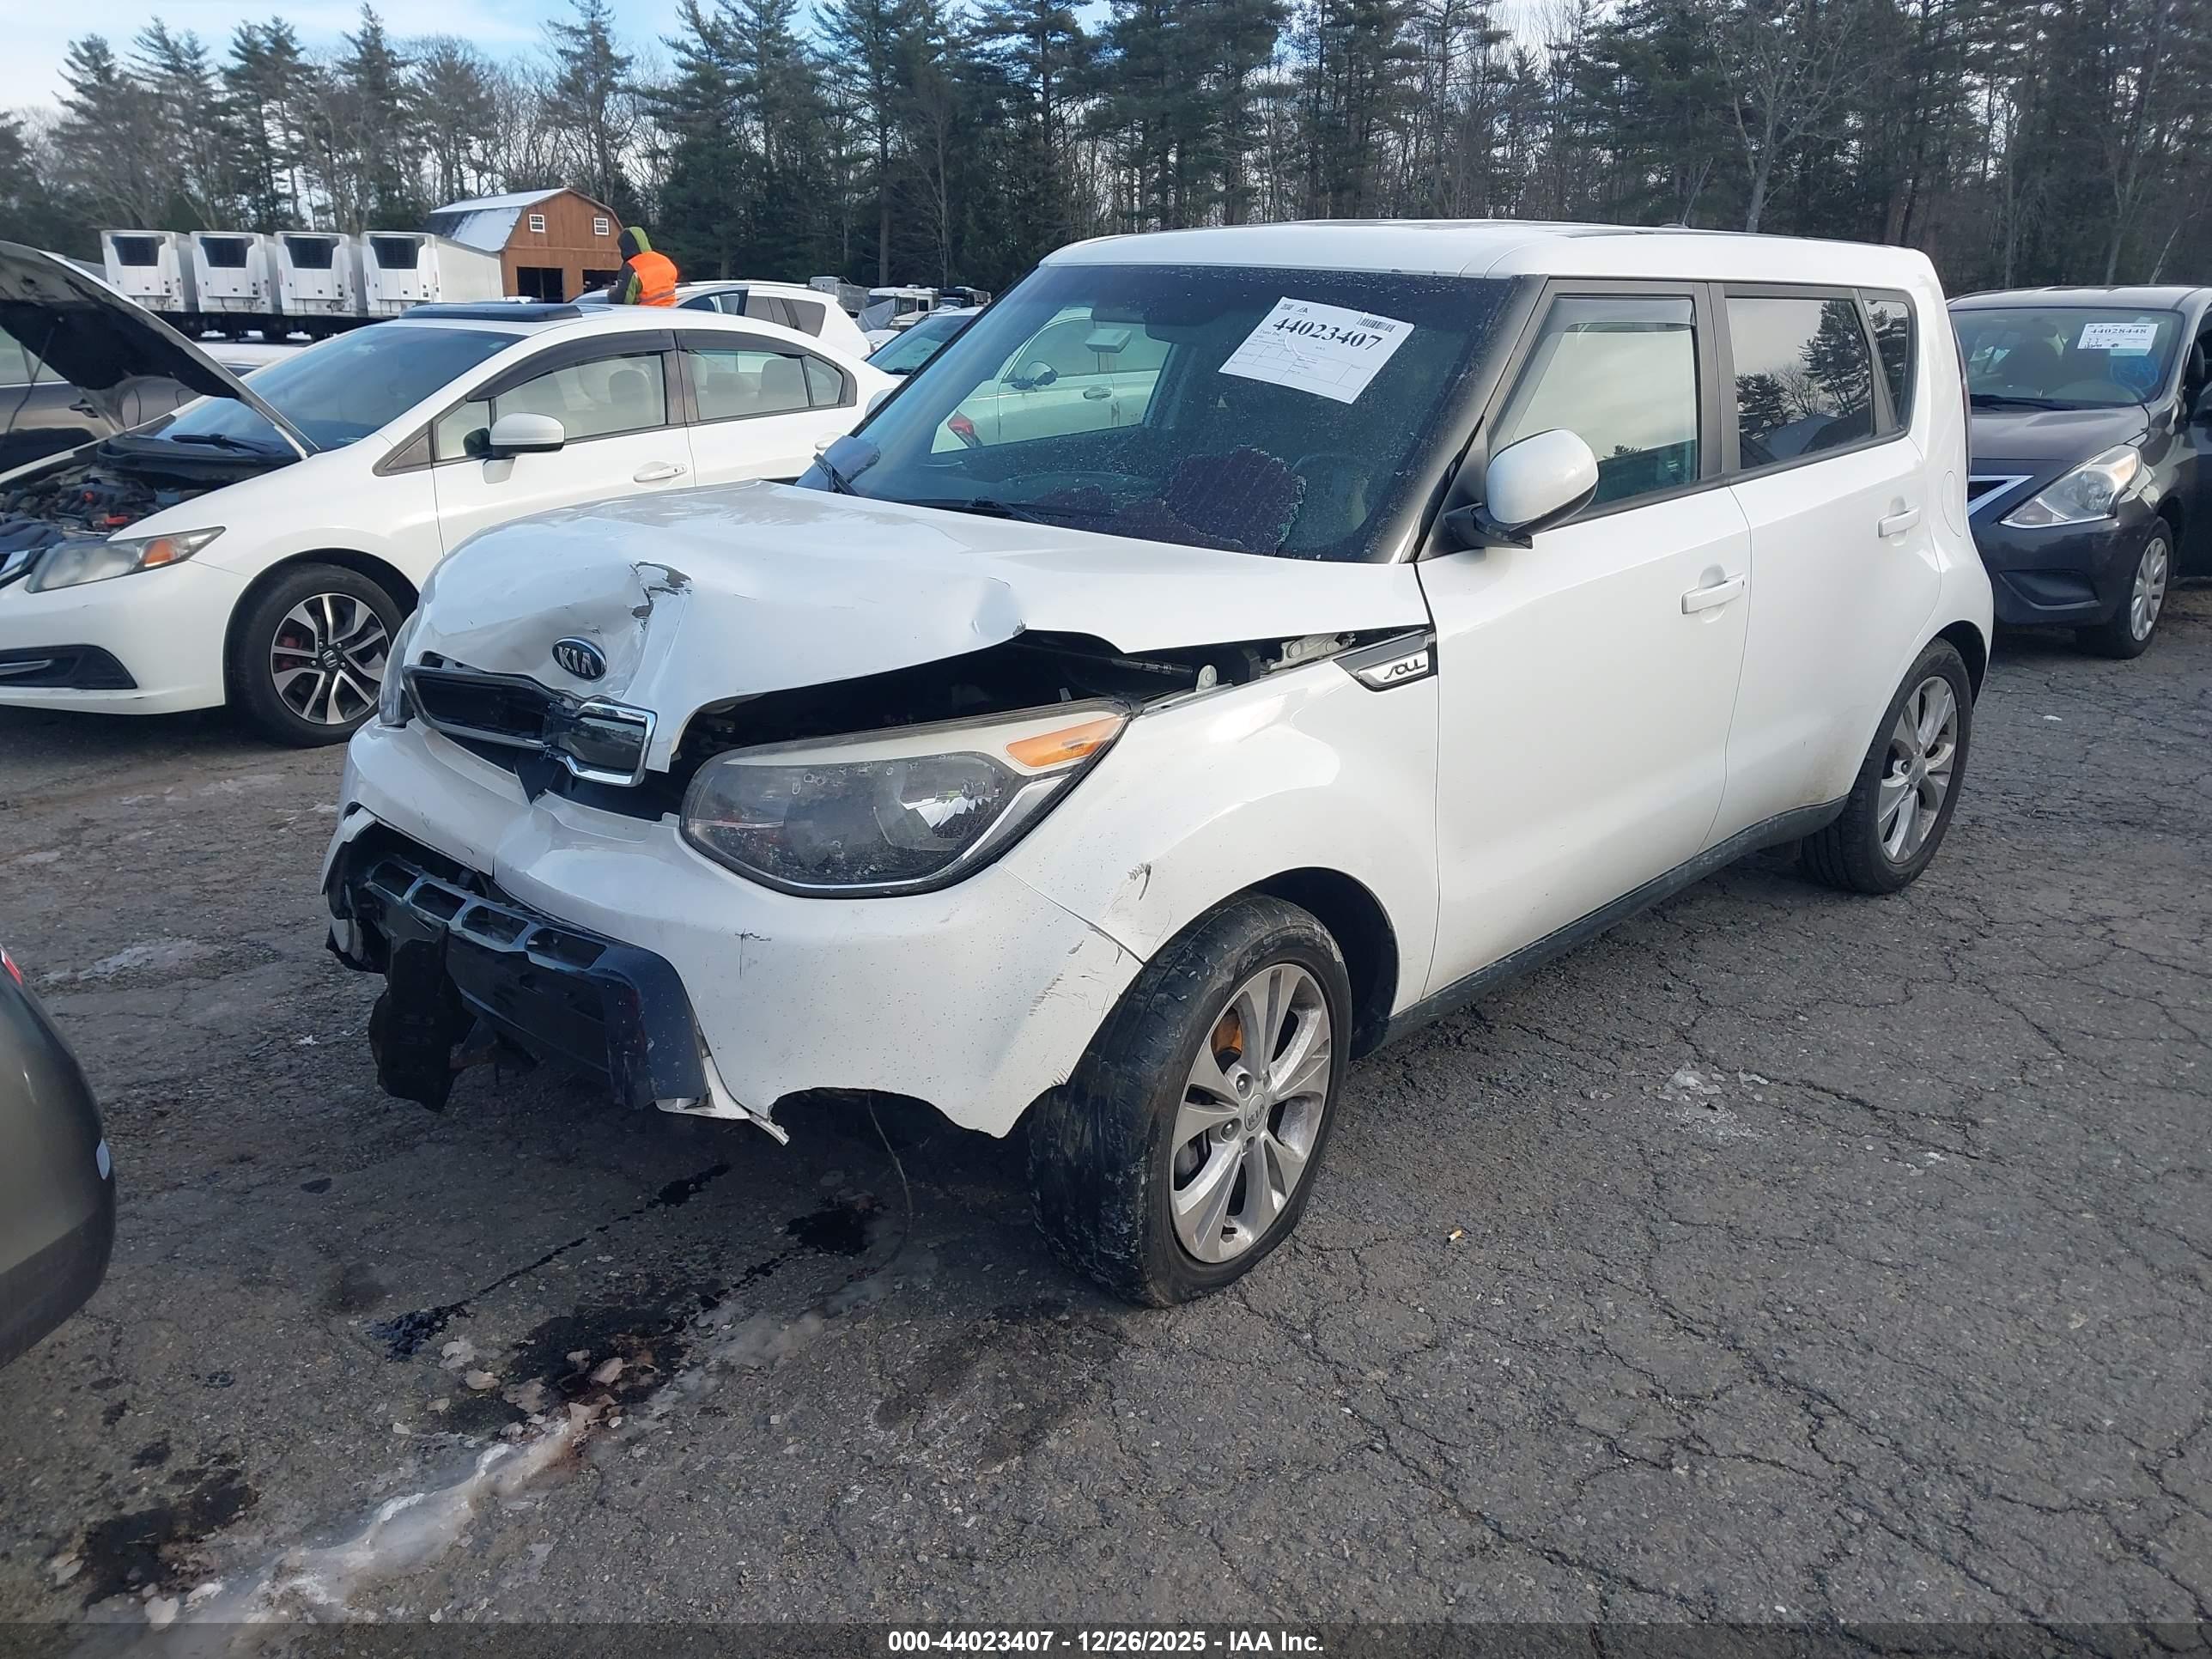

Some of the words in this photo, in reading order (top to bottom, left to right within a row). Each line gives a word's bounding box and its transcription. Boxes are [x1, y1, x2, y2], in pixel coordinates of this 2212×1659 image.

[1272, 317, 1383, 350] 44023407
[557, 646, 596, 677] KIA
[1383, 659, 1427, 680] SOUL
[1247, 1103, 1265, 1127] KIA
